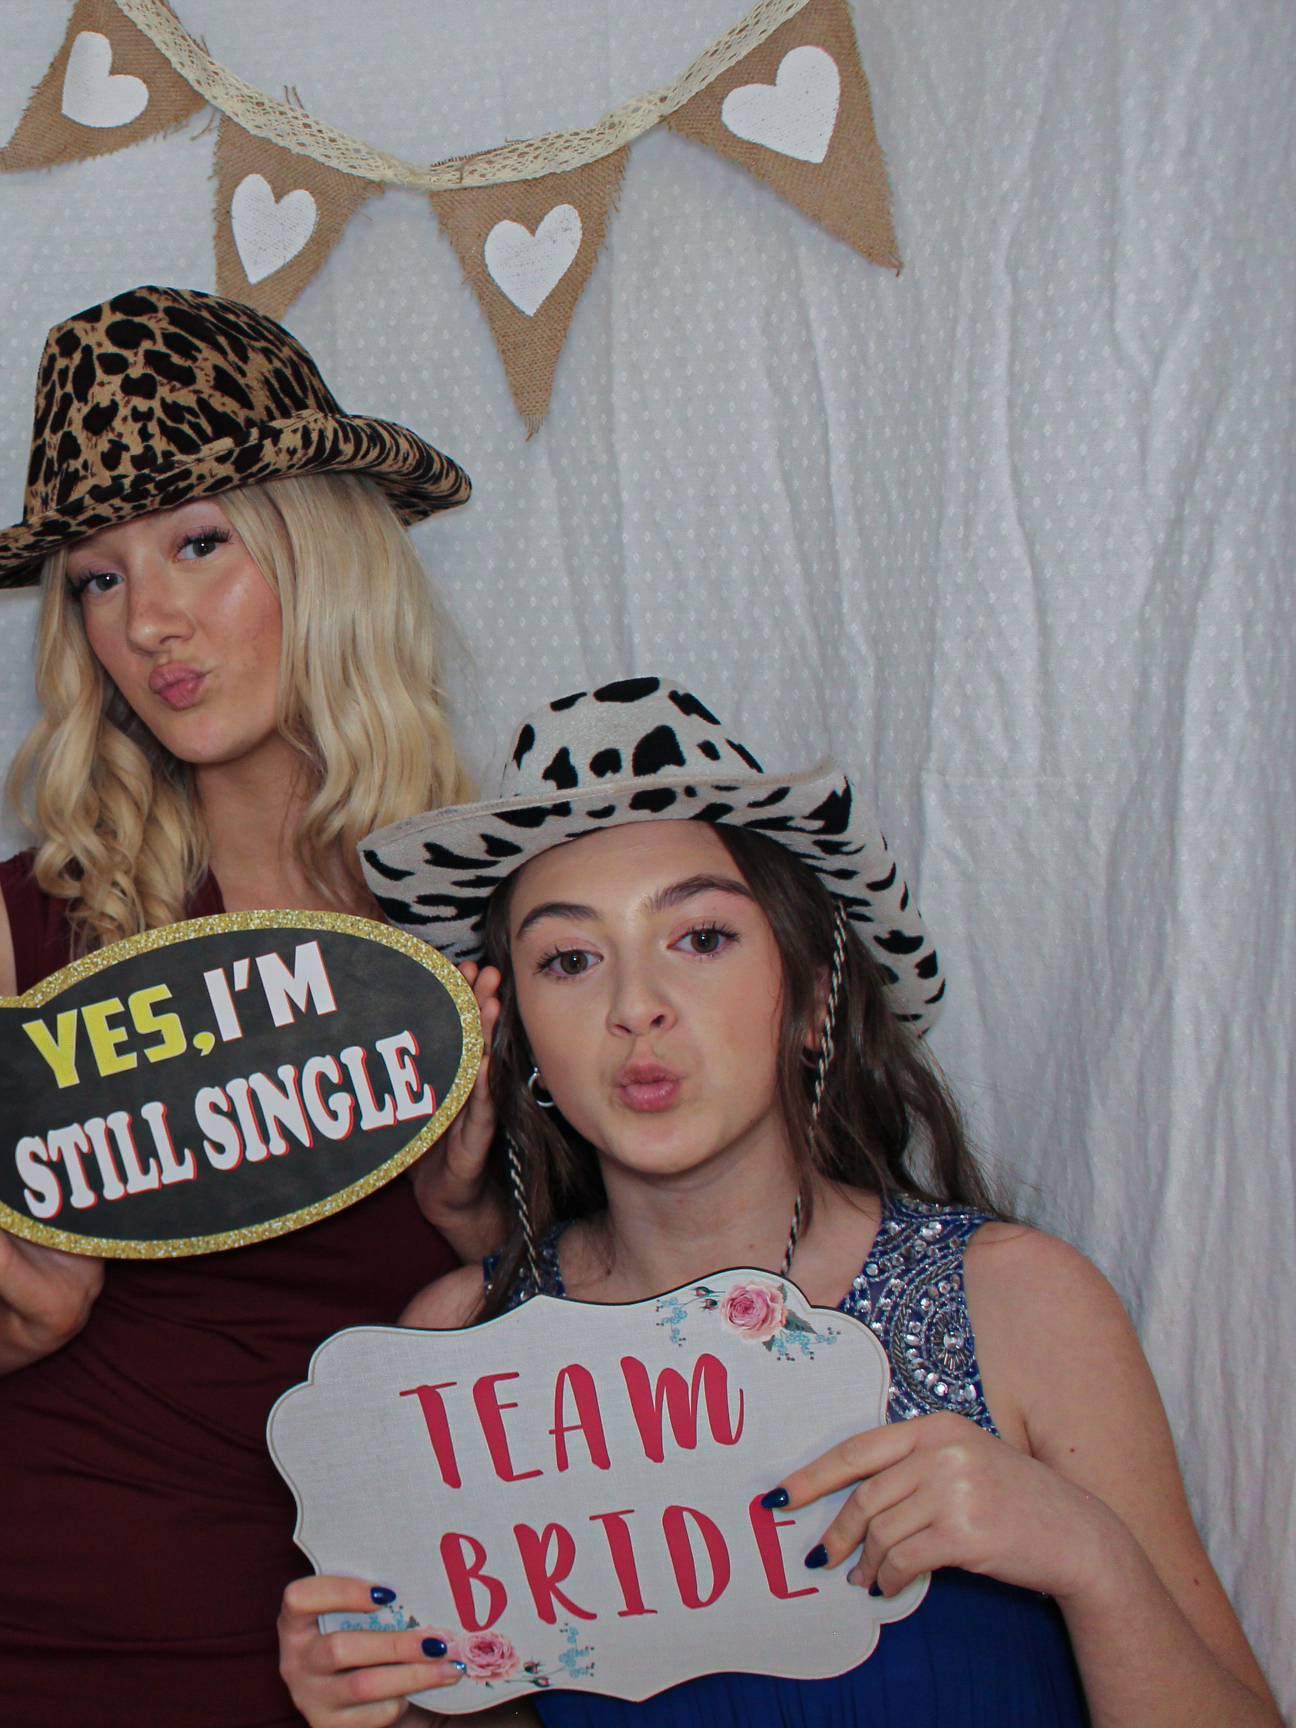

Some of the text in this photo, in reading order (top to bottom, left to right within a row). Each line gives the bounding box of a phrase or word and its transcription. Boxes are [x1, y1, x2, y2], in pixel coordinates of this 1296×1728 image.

[14, 1030, 436, 1219] STILL SINGLE
[399, 1353, 744, 1489] TEAM
[439, 1493, 819, 1633] BRIDE
